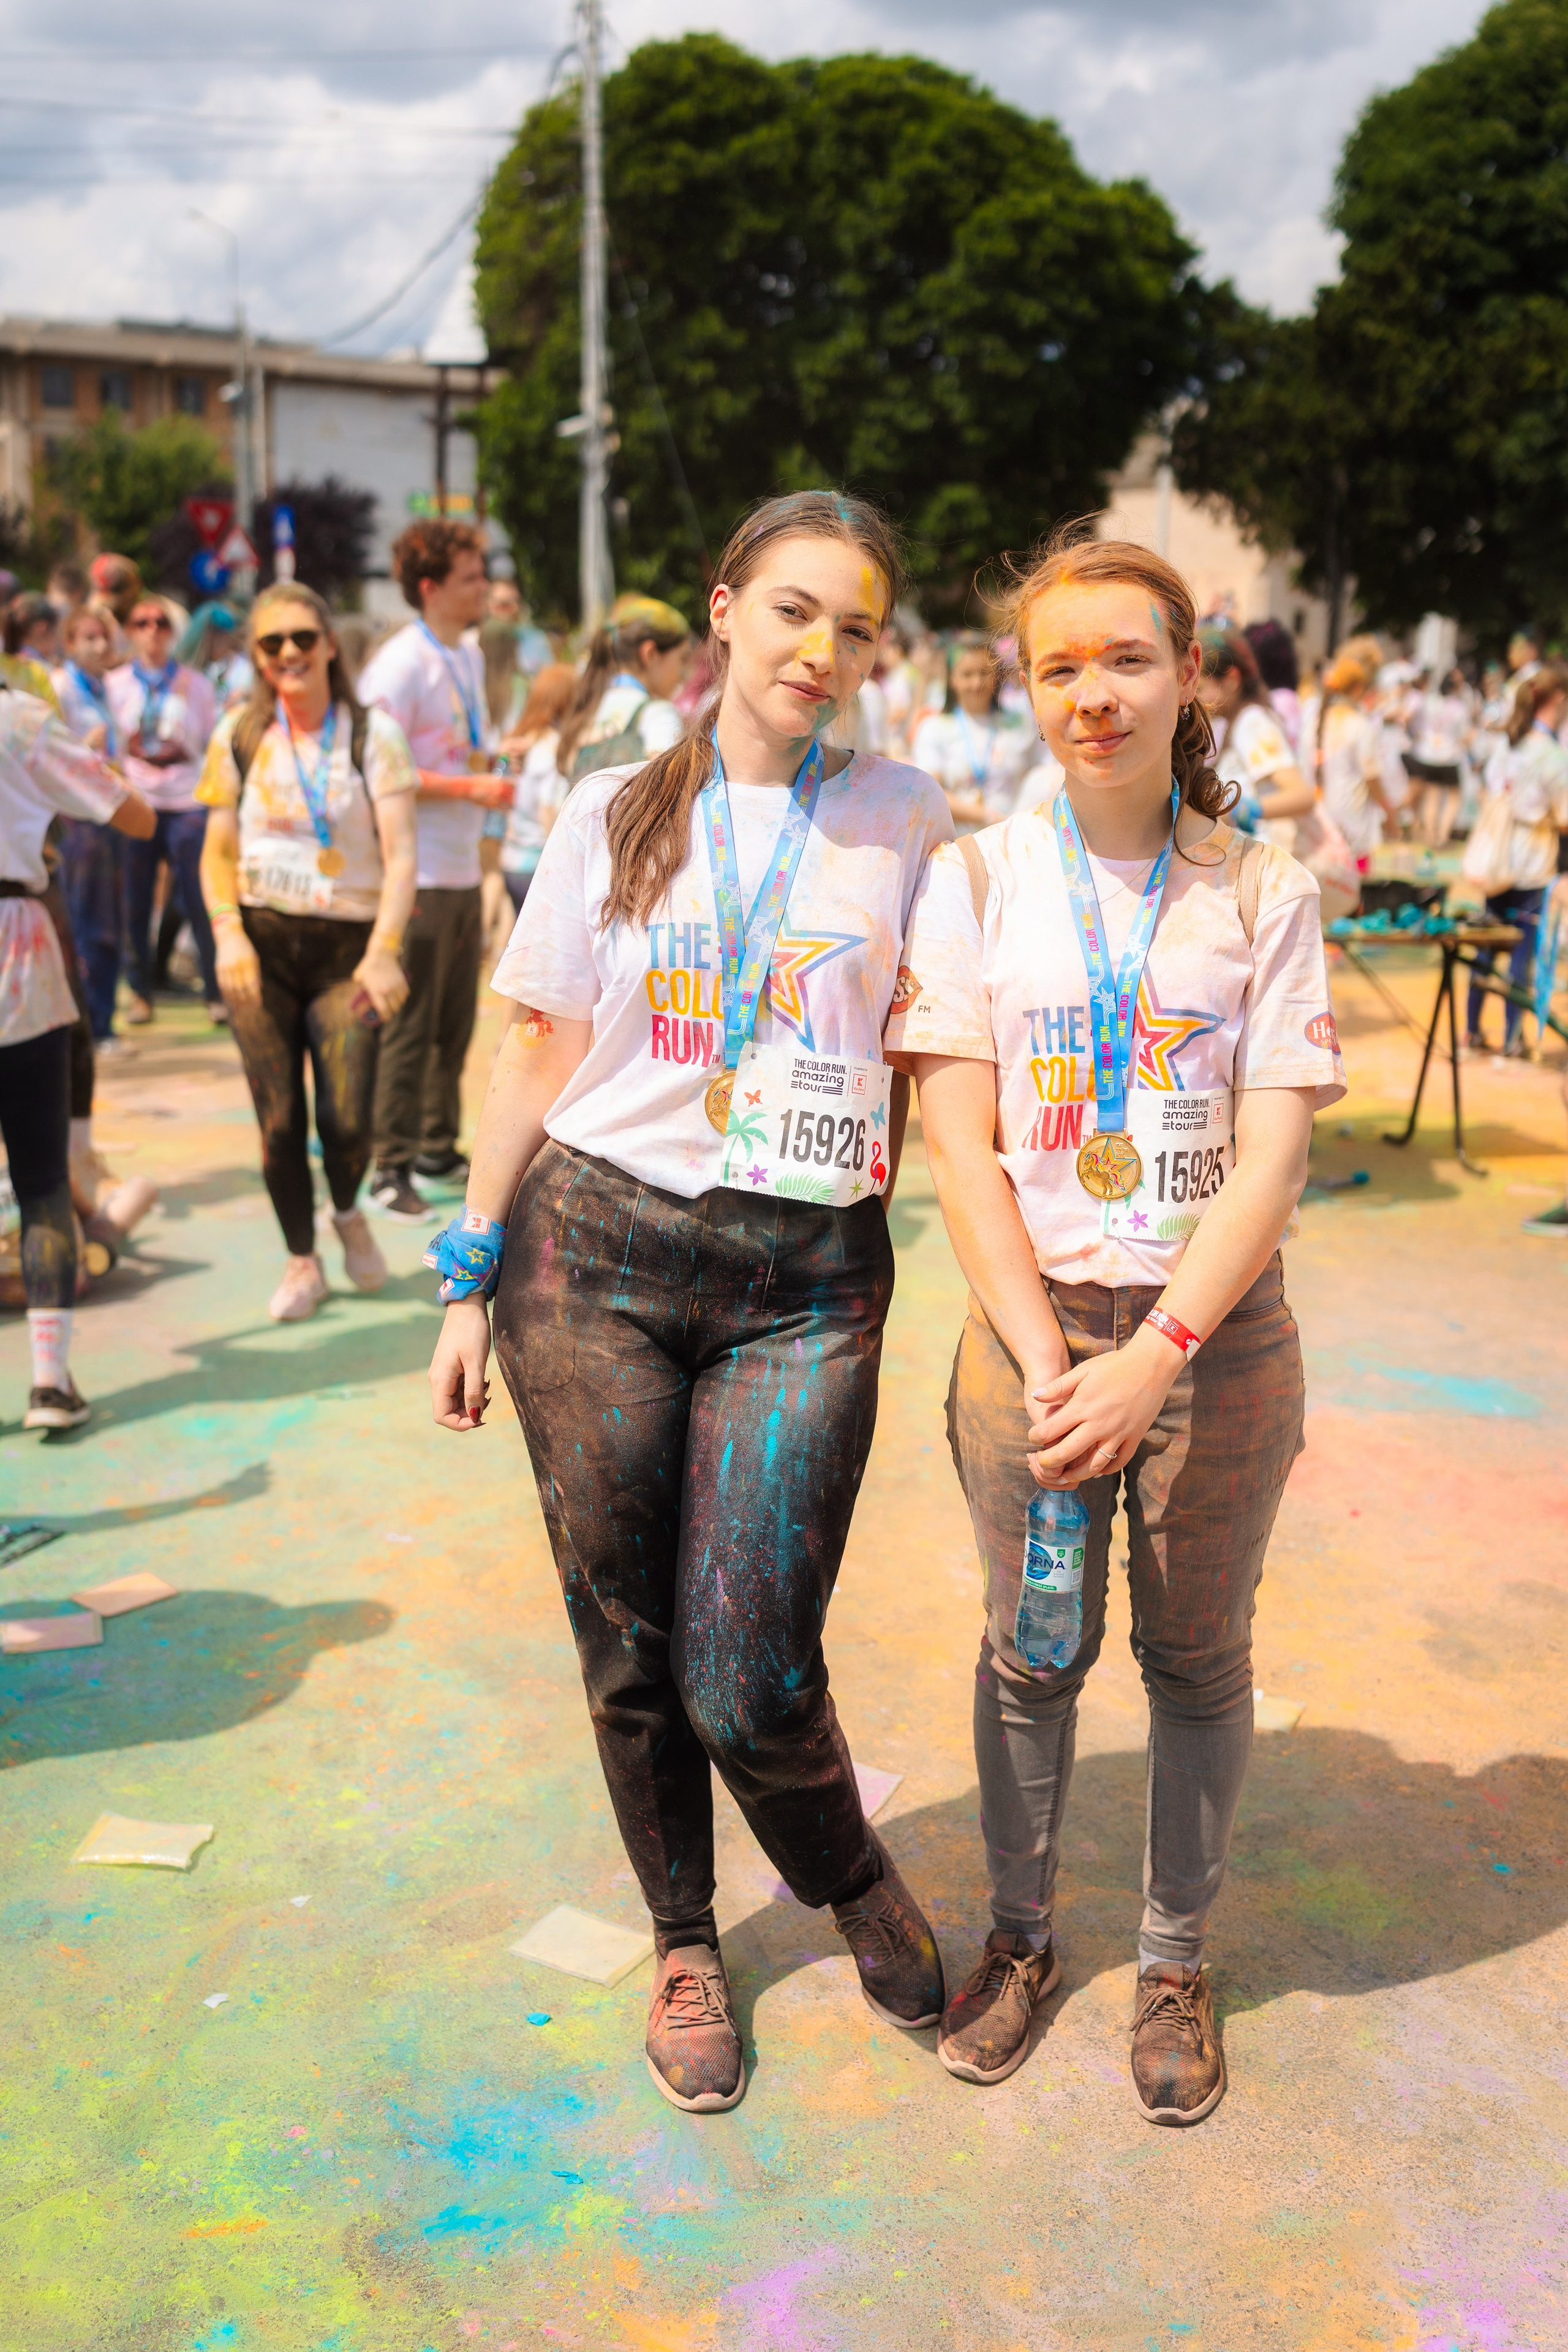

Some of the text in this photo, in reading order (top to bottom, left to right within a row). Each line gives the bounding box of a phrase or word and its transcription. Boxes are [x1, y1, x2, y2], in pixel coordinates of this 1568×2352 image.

[798, 763, 818, 808] THE COLOR RUN
[712, 811, 722, 825] THE
[712, 824, 726, 847] COLOR
[767, 856, 791, 908] THE COLOR RUN
[1152, 872, 1163, 886] THE
[1145, 885, 1159, 908] COLOR
[646, 922, 711, 969] THE
[725, 917, 739, 974] THE COLOR RUN
[1081, 913, 1102, 966] THE COLOR RUN
[738, 963, 761, 1018] THE COLOR RUN
[1121, 979, 1132, 993] THE
[1117, 995, 1129, 1020] COLOR
[652, 1014, 714, 1068] RUN
[1022, 1006, 1085, 1055] THE
[794, 1058, 807, 1069] THE
[807, 1061, 831, 1072] COLOR
[1100, 1026, 1114, 1084] THE COLOR RUN
[792, 1070, 844, 1087] amazing
[799, 1080, 821, 1093] tour
[1163, 1109, 1208, 1121] amazing
[1164, 1099, 1177, 1109] THE
[1178, 1099, 1199, 1109] COLOR
[1170, 1121, 1193, 1131] tour
[779, 1109, 866, 1171] 15926
[1155, 1146, 1224, 1203] 15925
